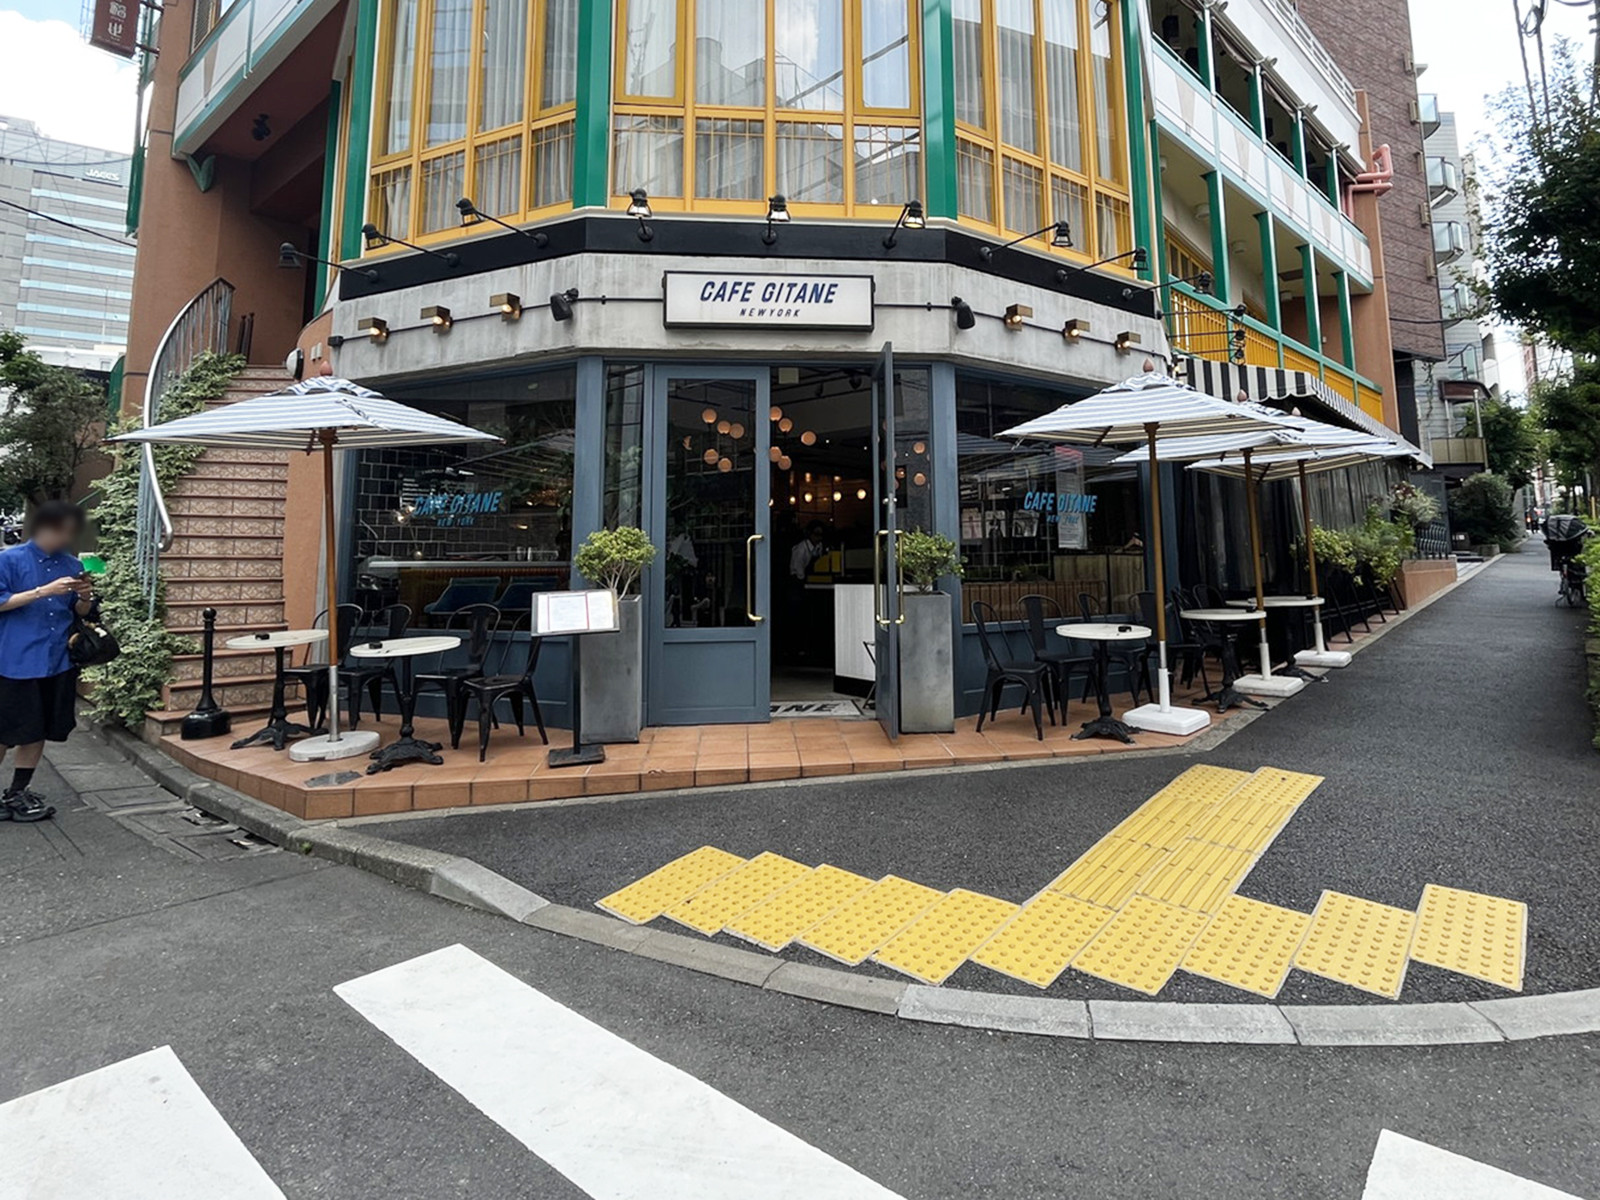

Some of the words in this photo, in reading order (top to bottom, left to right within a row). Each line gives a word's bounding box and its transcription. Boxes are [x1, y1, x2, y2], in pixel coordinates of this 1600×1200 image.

[700, 281, 756, 302] CAFE
[761, 282, 838, 304] GITANE
[413, 494, 449, 517] CAFE
[449, 491, 503, 514] GITANE
[1024, 492, 1055, 510] CAFE
